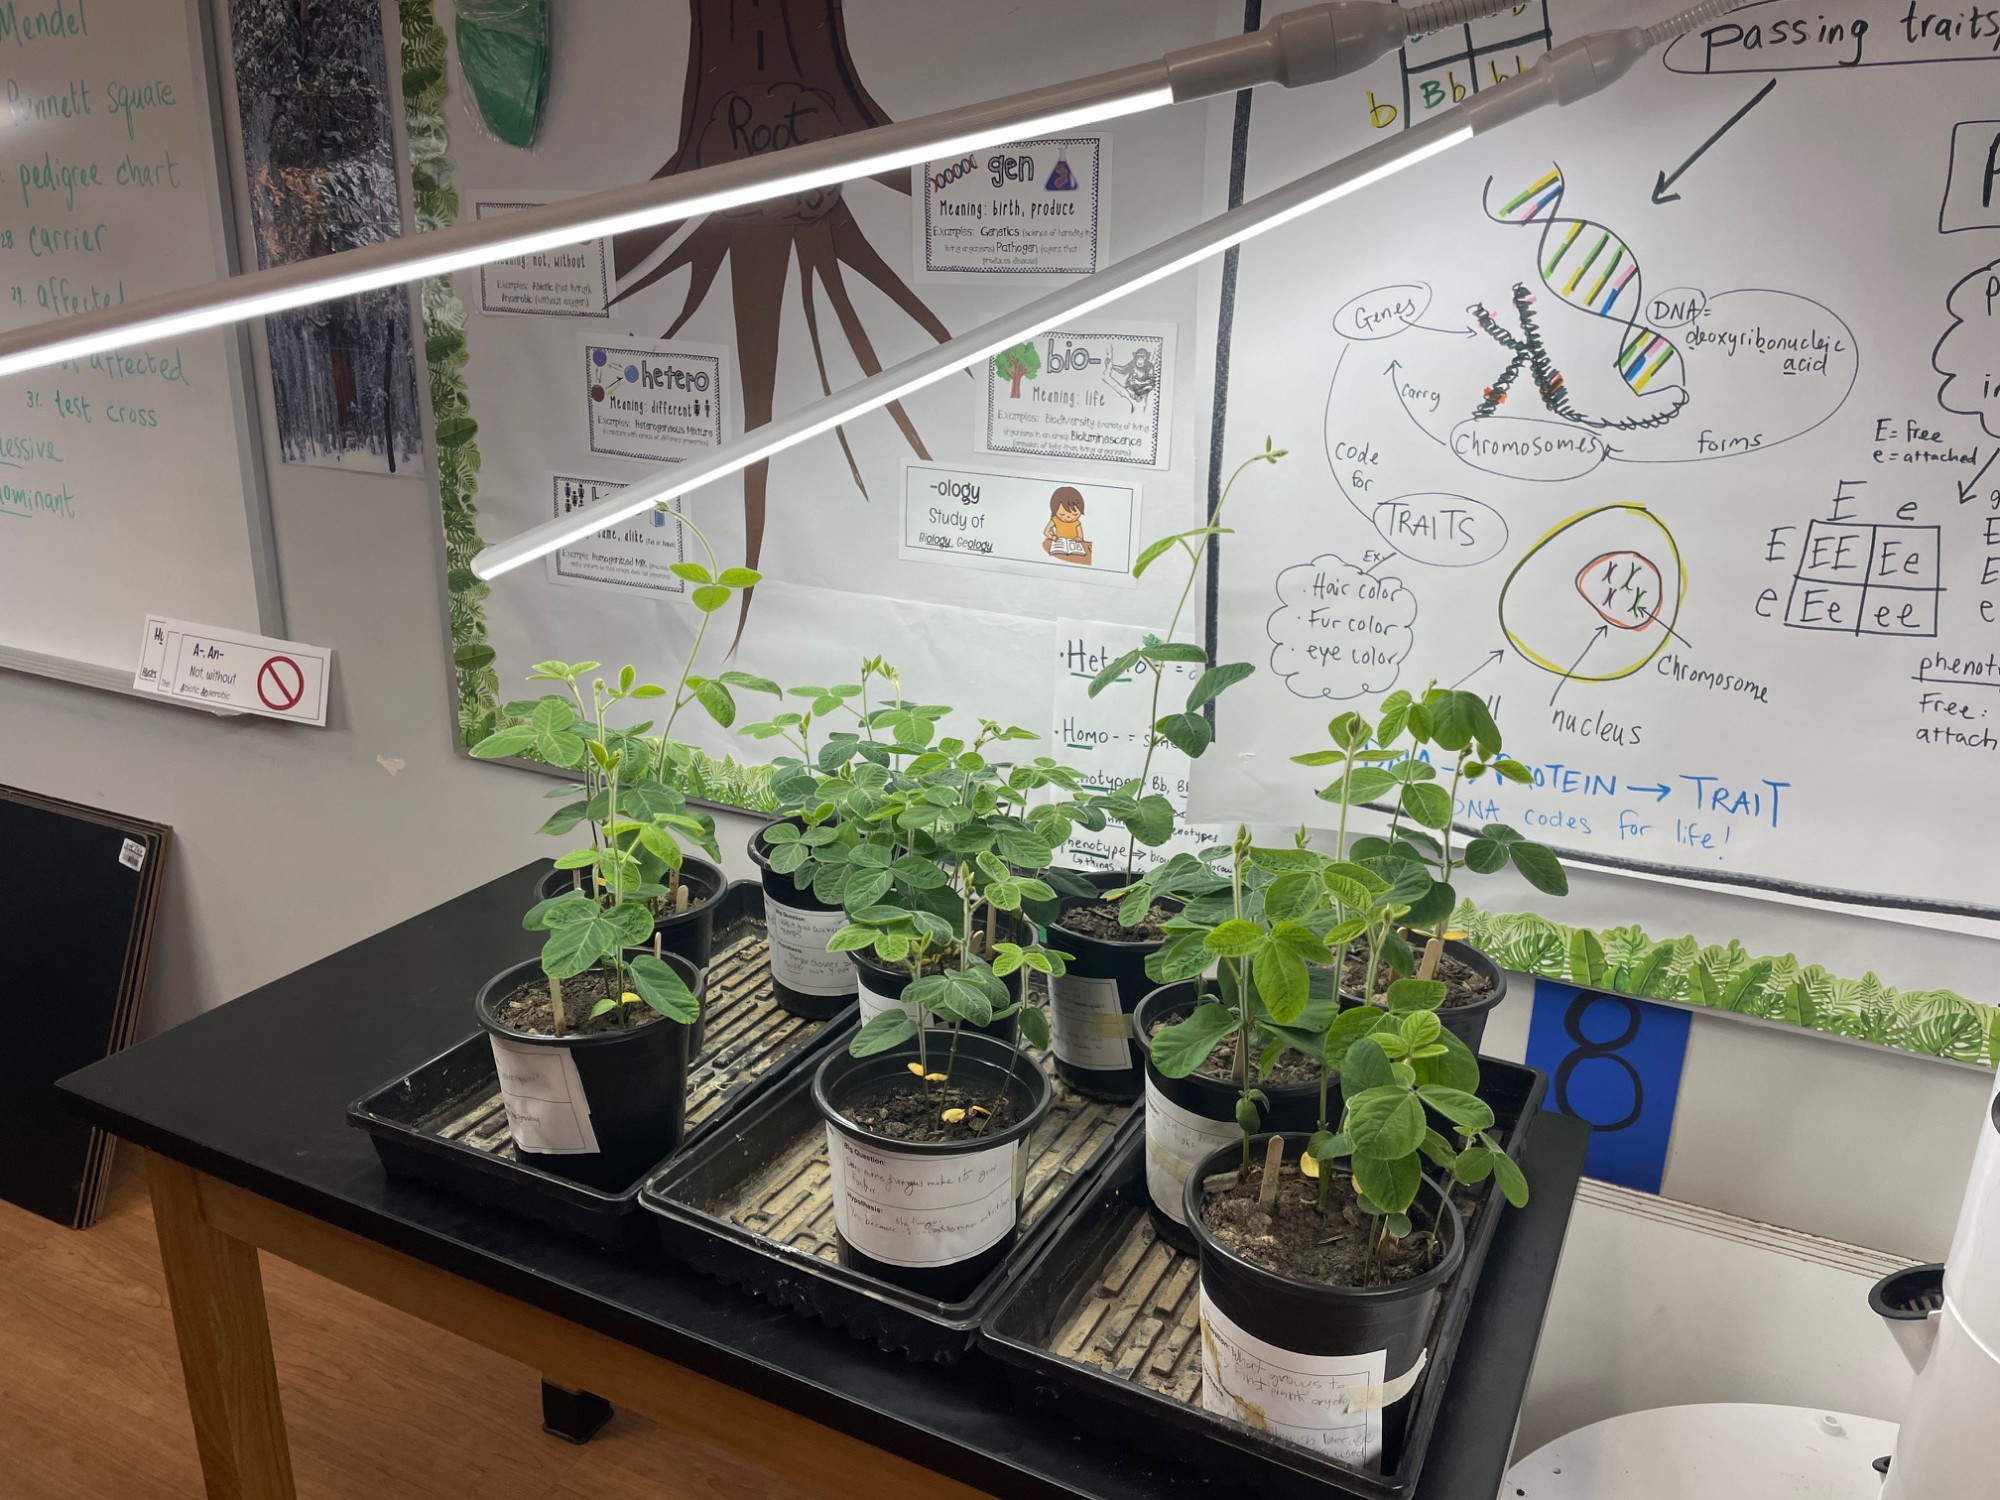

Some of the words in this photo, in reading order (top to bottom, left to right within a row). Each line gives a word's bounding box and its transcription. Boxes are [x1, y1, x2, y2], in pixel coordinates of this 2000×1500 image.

[0, 0, 88, 47] Mendel
[107, 80, 176, 140] square
[727, 96, 820, 156] Root
[20, 152, 102, 212] pedigree
[116, 151, 180, 188] chart
[987, 154, 1035, 188] gen
[940, 200, 987, 219] Meaning:
[992, 200, 1025, 218] birth,
[1030, 200, 1075, 219] produce
[29, 223, 107, 257] carrier
[980, 225, 1020, 238] Genetics
[996, 241, 1038, 256] Pathogen
[1354, 298, 1416, 333] Genes
[1046, 338, 1101, 374] bio-
[1685, 325, 1846, 357] deoxyribonucleic
[641, 360, 711, 393] hetero
[1783, 352, 1829, 376] acid
[54, 389, 92, 423] test
[106, 405, 158, 427] cross
[609, 394, 648, 416] Meaning:
[651, 399, 693, 418] different
[1032, 385, 1080, 409] Meaning:
[1085, 390, 1106, 407] life
[1401, 383, 1442, 413] carry
[1697, 429, 1763, 455] forms
[1903, 446, 1978, 466] attached
[0, 483, 75, 519] ominant
[930, 478, 981, 505] -ology
[928, 506, 968, 532] Study
[971, 512, 986, 529] of
[1377, 501, 1476, 547] TRAITS
[918, 531, 953, 548] Biology,
[956, 535, 994, 554] Geology
[1313, 572, 1350, 600] Hair
[1358, 578, 1402, 602] color
[1308, 606, 1342, 629] Fur
[1348, 615, 1398, 636] color
[1306, 644, 1341, 667] eye
[1351, 645, 1398, 667] color
[1918, 651, 2000, 683] phenot
[206, 668, 238, 685] without
[1551, 709, 1643, 747] nucleus
[1494, 752, 1617, 798] POTEIN
[1678, 773, 1792, 829] TRAIT
[1171, 826, 1219, 843] enotypes
[1524, 809, 1592, 835] codes
[1619, 809, 1653, 841] for
[1555, 988, 1643, 1132] 8
[853, 1148, 888, 1167] Question:
